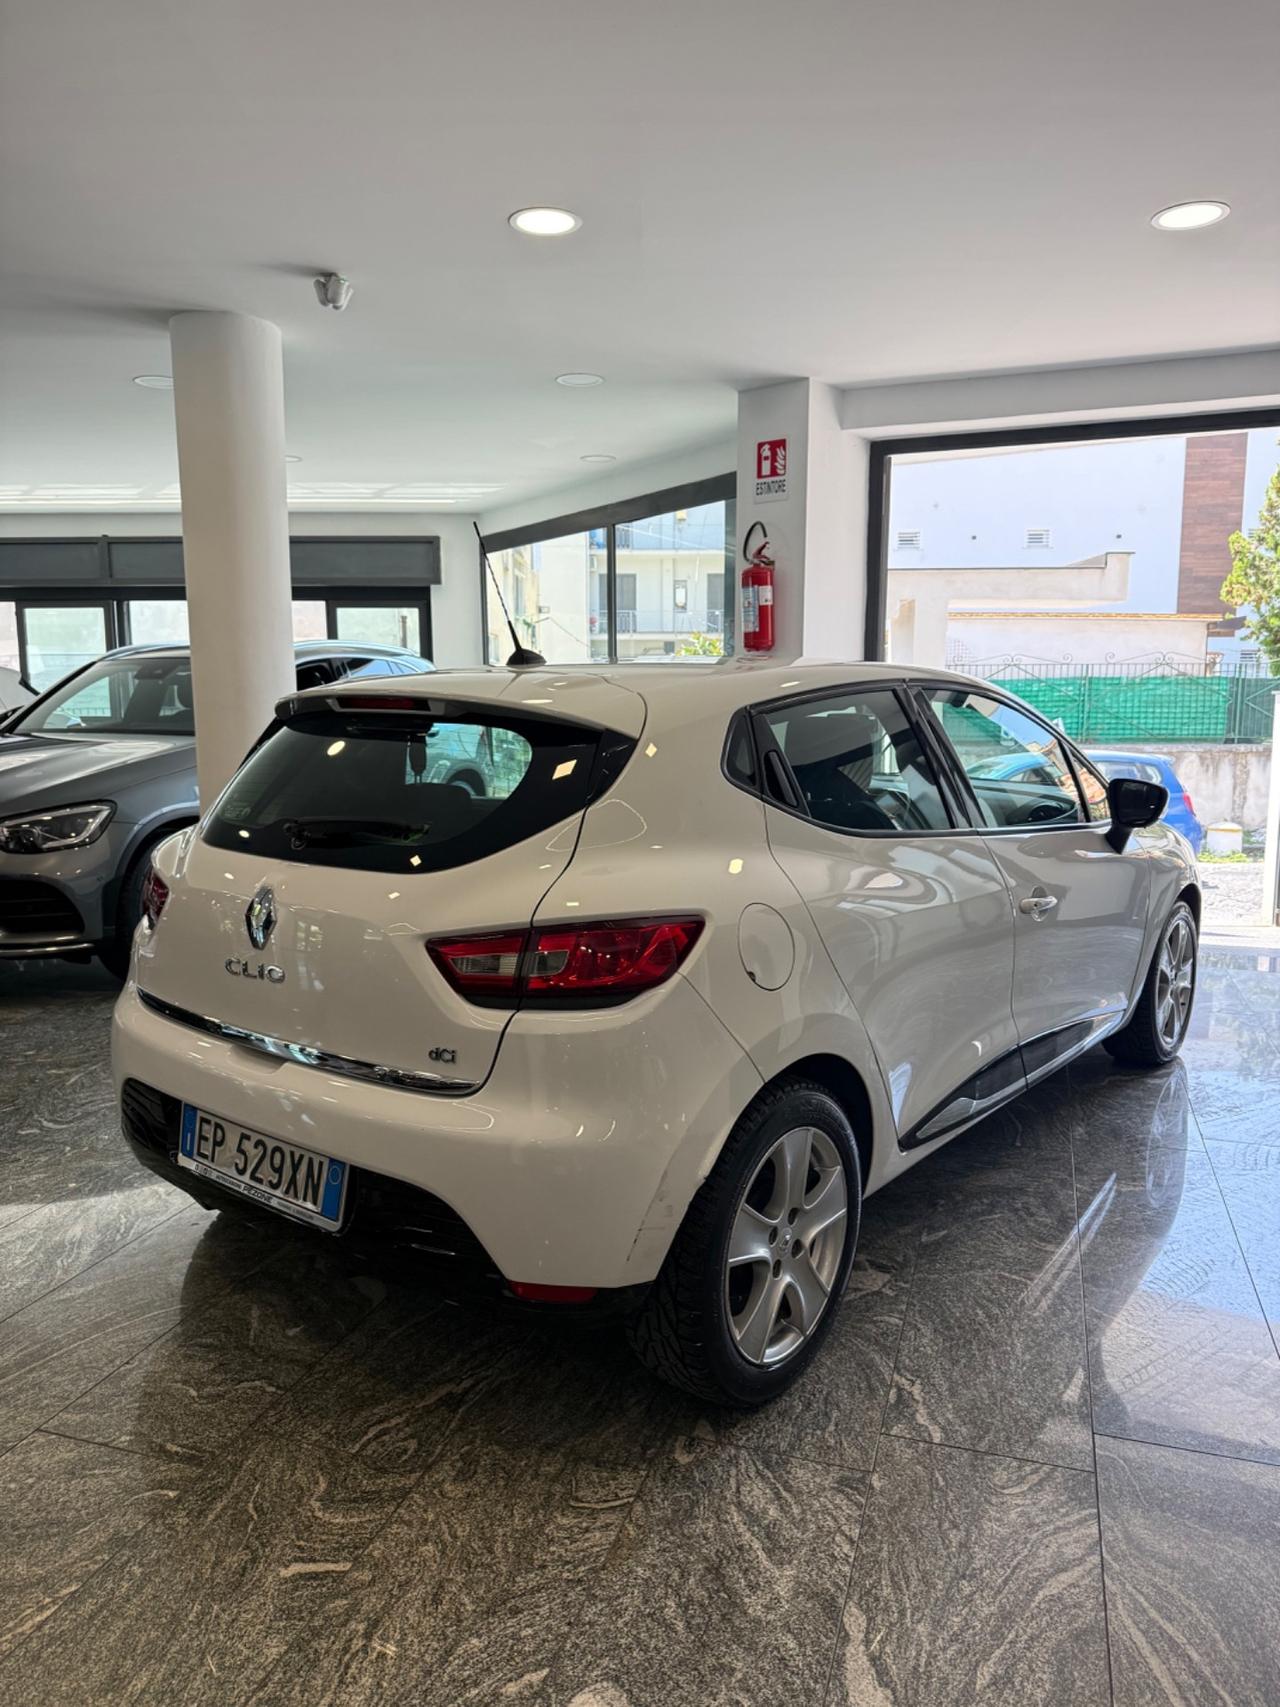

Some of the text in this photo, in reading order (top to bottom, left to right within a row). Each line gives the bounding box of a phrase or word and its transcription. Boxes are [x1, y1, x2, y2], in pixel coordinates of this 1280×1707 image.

[756, 479, 786, 496] ESTINTORE
[225, 957, 286, 984] CLIO
[428, 1047, 457, 1065] dCi
[196, 1115, 324, 1206] EP 529XN
